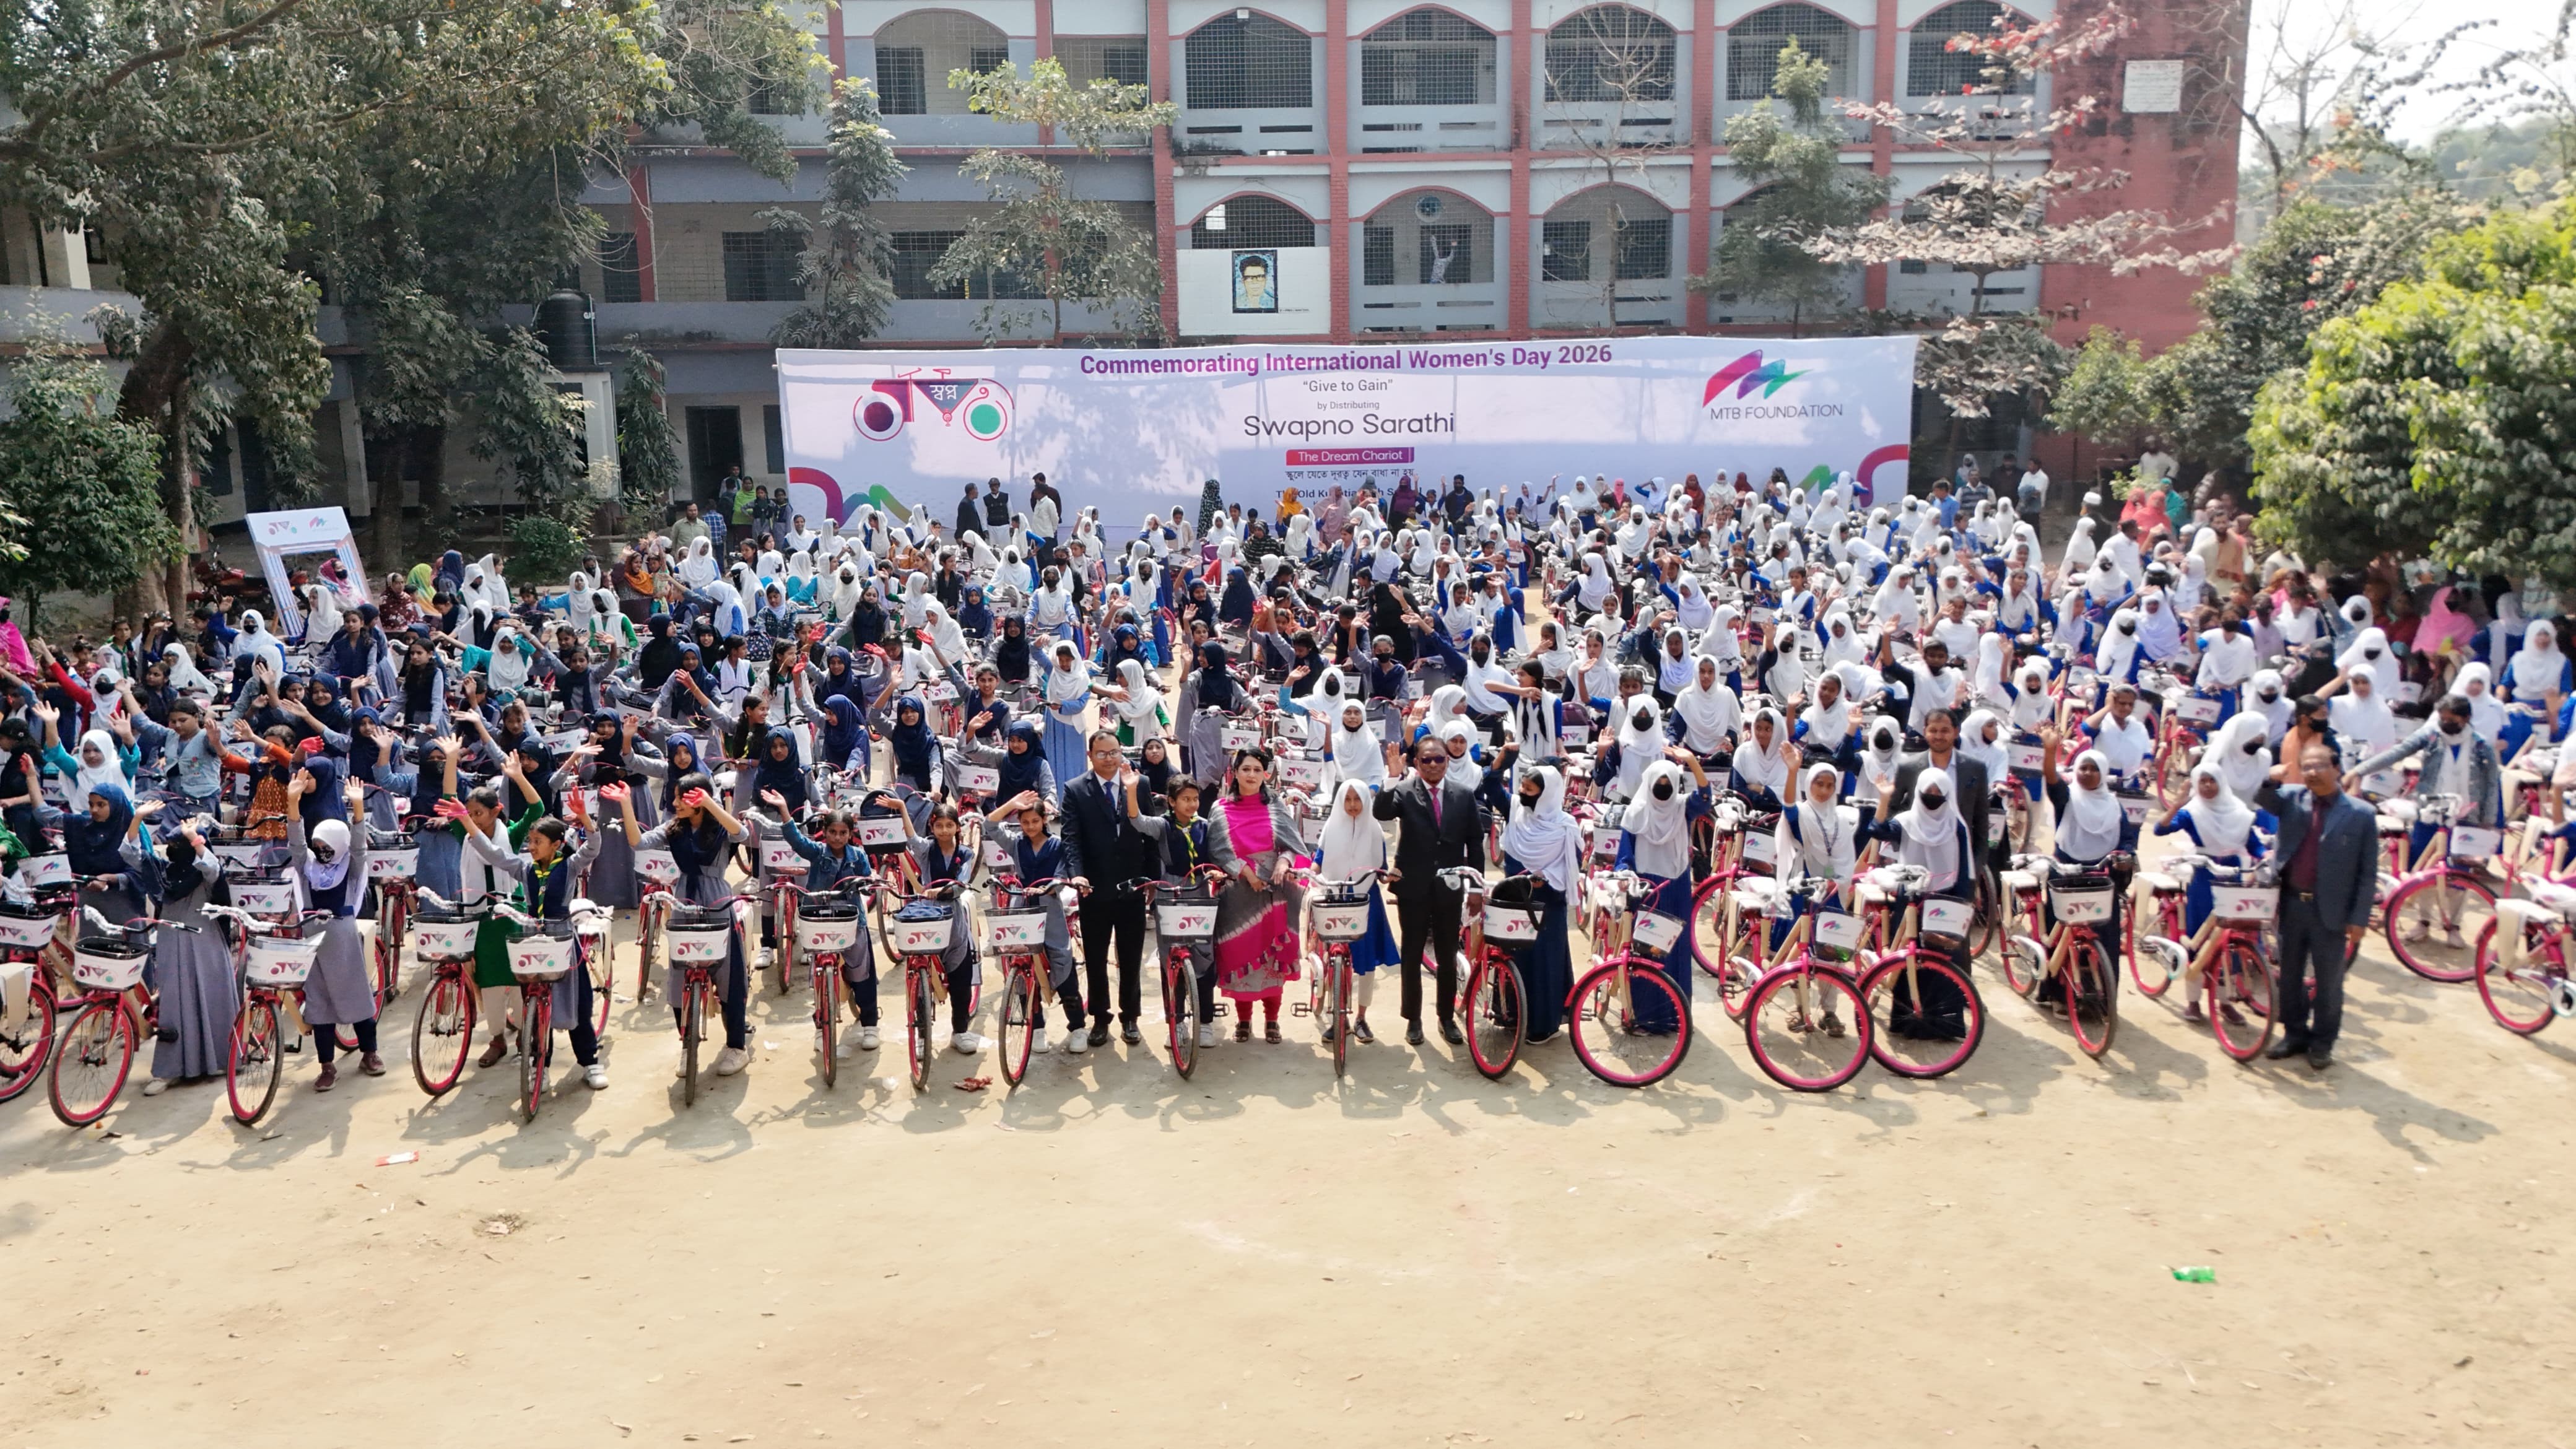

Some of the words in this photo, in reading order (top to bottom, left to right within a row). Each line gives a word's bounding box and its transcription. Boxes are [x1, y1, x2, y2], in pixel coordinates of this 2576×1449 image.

[1081, 352, 1259, 376] Commemorating
[1266, 350, 1401, 371] International
[1408, 348, 1505, 368] Women's
[1512, 347, 1551, 369] Day
[1558, 344, 1612, 363] 2026
[1341, 380, 1354, 391] to
[929, 385, 959, 401] স্বপ্ন
[1317, 401, 1327, 411] by
[1329, 401, 1380, 411] Distributing
[1710, 407, 1741, 420] MTB
[1745, 404, 1843, 419] FOUNDATION
[1244, 416, 1354, 442] Swapno
[1363, 412, 1454, 434] Sarathi
[1298, 451, 1318, 462] The
[1321, 451, 1359, 461] Dream
[1362, 450, 1403, 461] Chariot
[1307, 471, 1328, 479] যেতে
[1370, 469, 1388, 477] বাধা
[1390, 469, 1399, 477] না
[1298, 489, 1315, 498] Old
